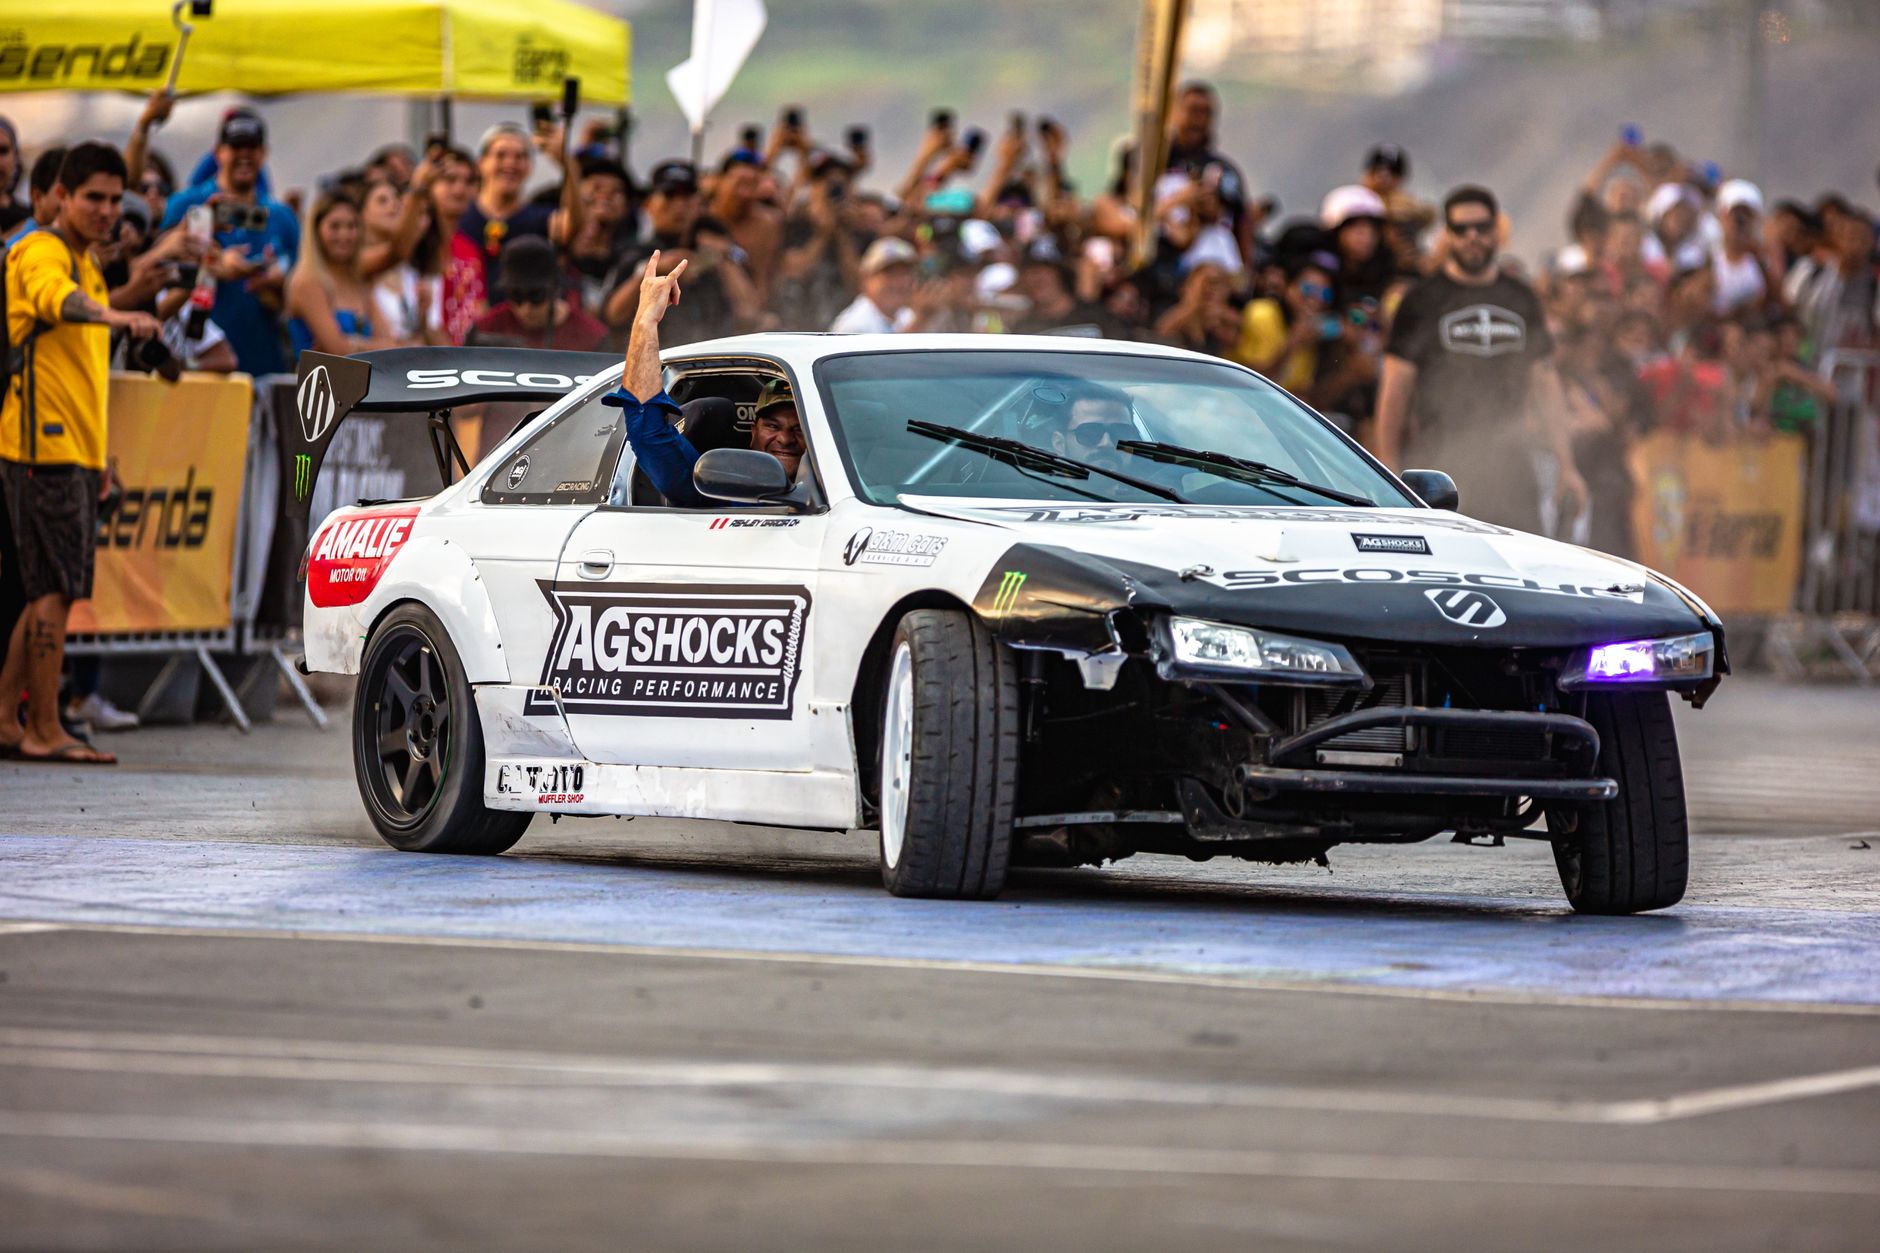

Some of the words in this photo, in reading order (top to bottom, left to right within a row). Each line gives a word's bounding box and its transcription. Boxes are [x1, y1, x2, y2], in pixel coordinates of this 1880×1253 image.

[97, 465, 214, 549] enda
[315, 518, 412, 561] AMALIE
[329, 567, 354, 583] MOTOR
[354, 567, 367, 582] OIL
[541, 675, 622, 695] RACING
[633, 679, 779, 699] PERFORMANCE
[538, 794, 566, 804] MUFFLER
[567, 794, 585, 804] SHOP
